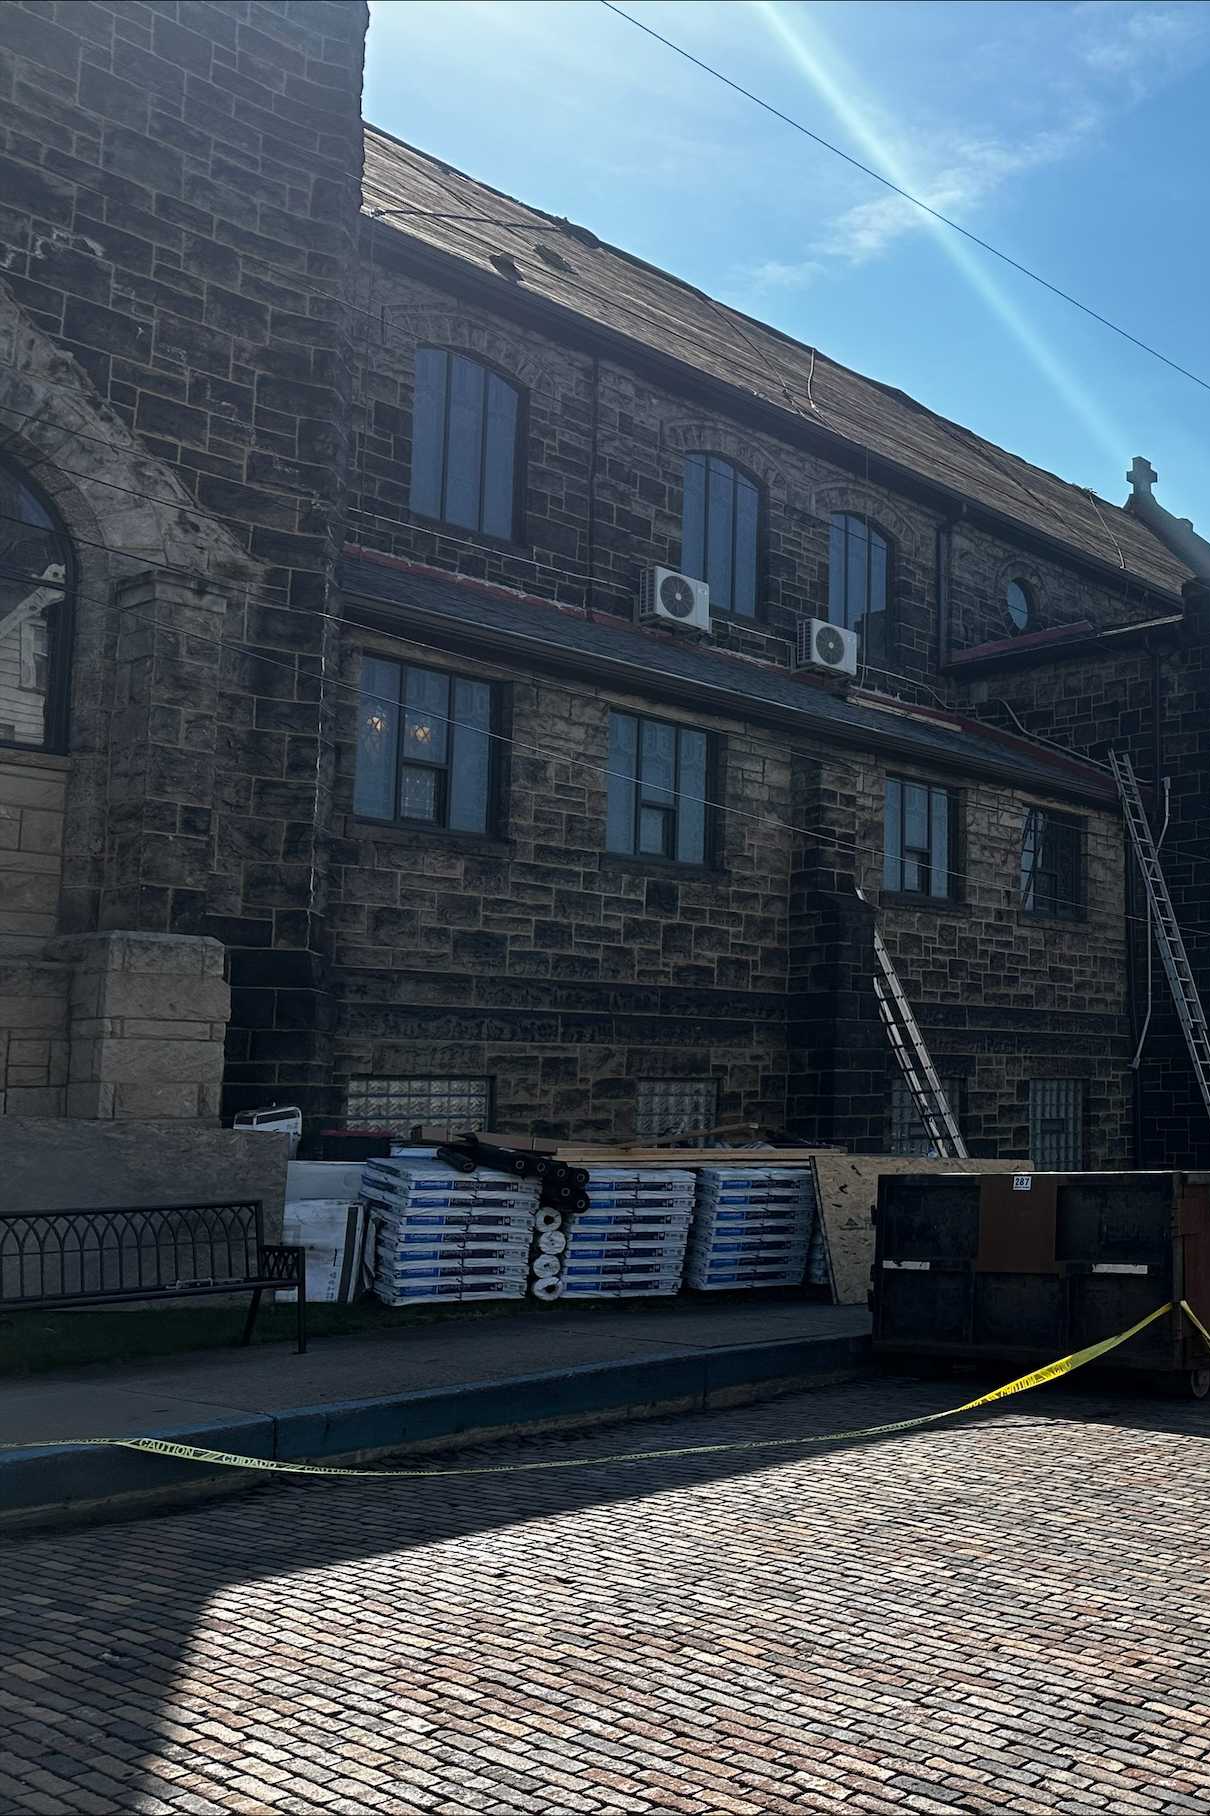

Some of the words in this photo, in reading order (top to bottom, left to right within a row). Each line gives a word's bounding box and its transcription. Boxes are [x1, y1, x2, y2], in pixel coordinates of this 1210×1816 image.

[1015, 1177, 1030, 1186] 287
[139, 1439, 194, 1457] CAUTION
[222, 1454, 279, 1469] CUIDADO
